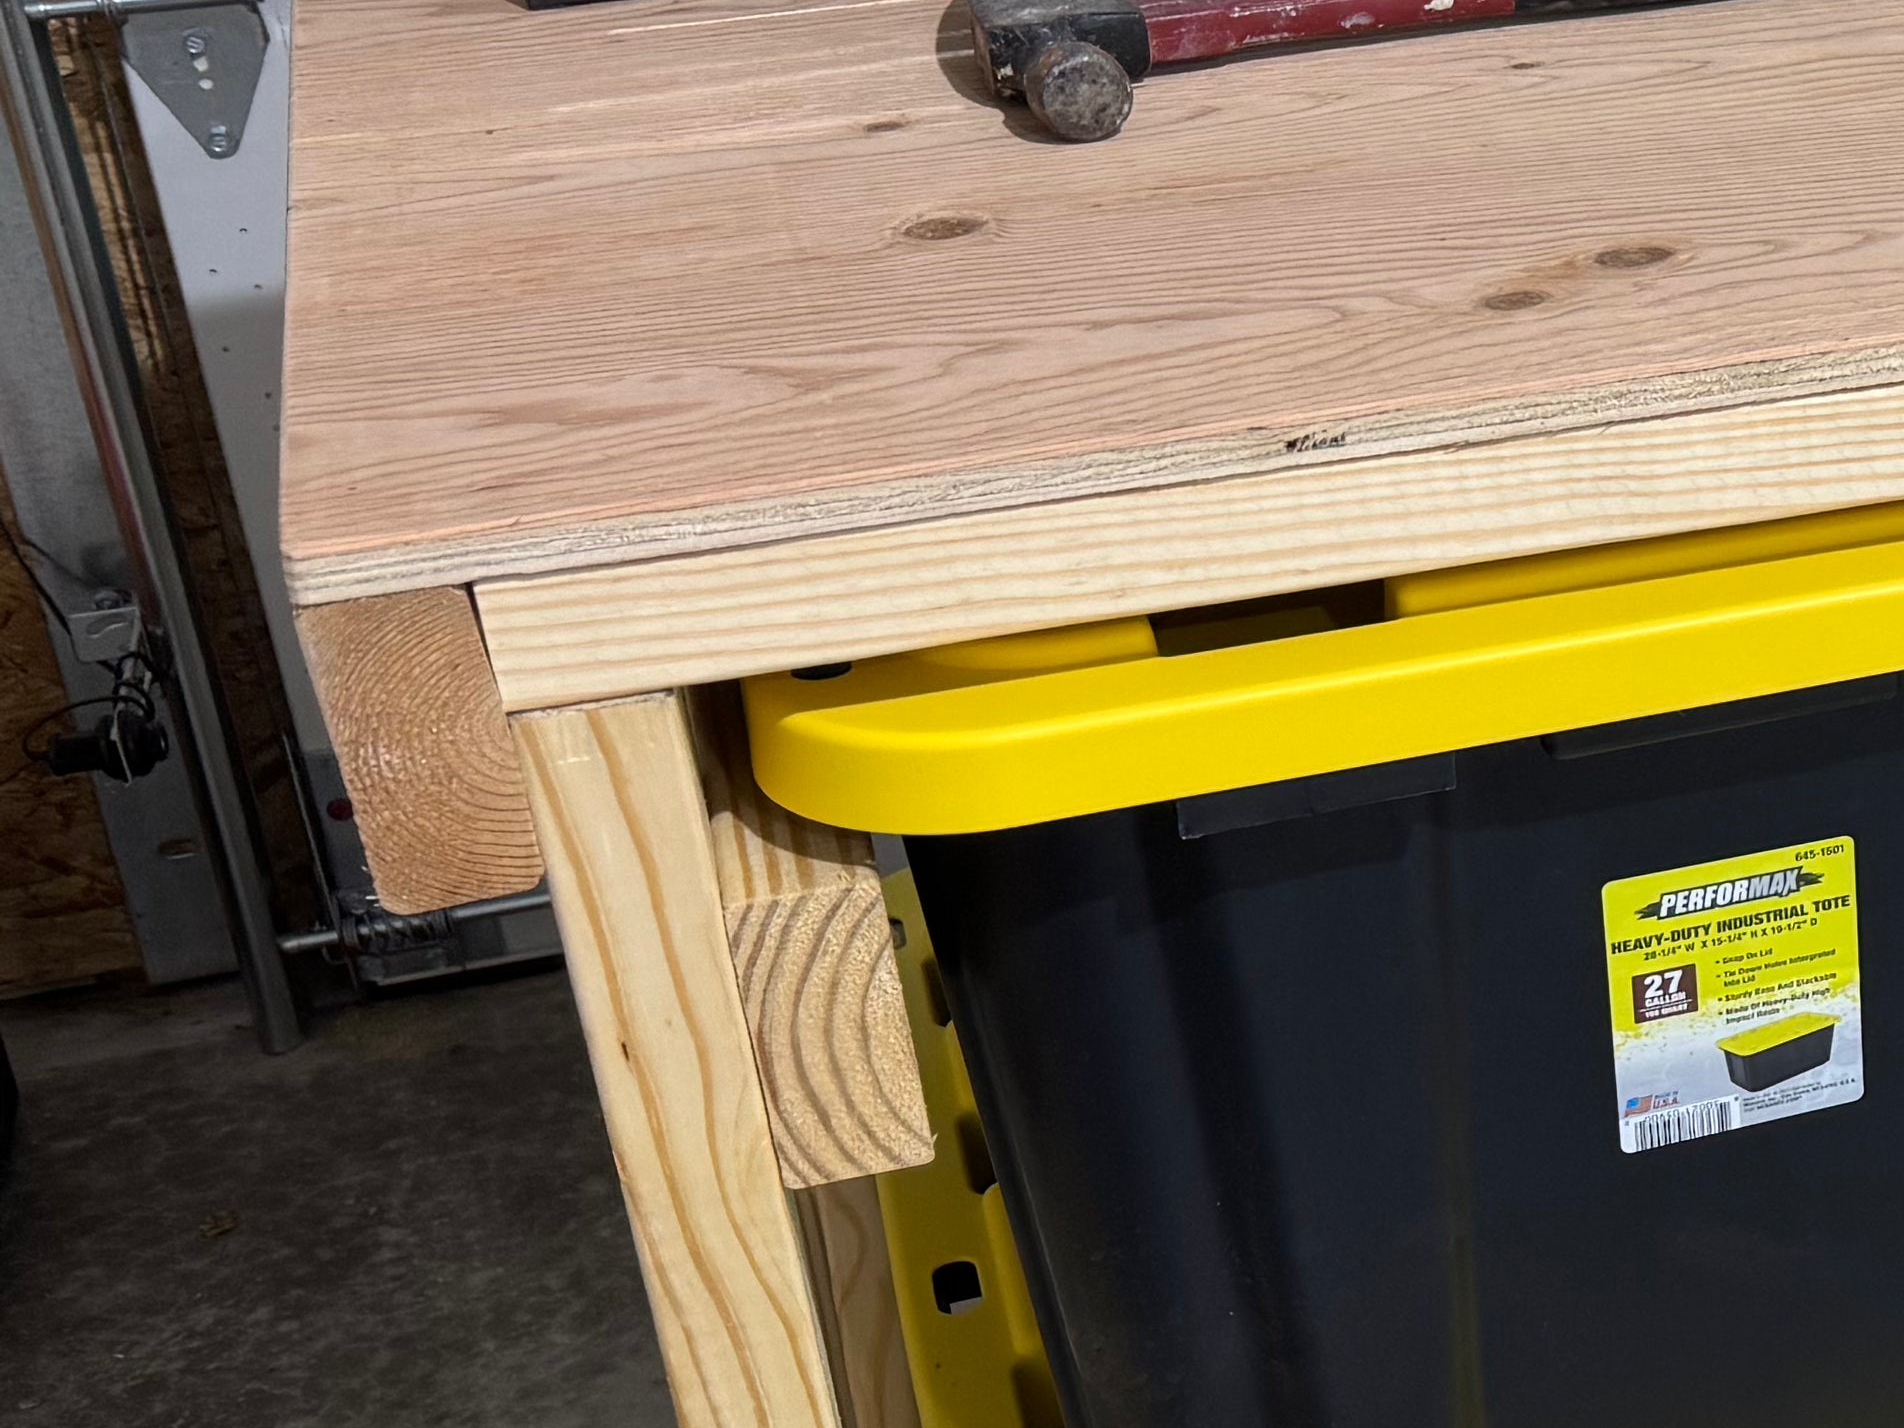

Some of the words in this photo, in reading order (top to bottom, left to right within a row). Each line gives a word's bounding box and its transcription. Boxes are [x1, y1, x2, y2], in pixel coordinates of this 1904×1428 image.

[1659, 868, 1798, 917] PERFORMAX
[1610, 922, 1711, 954] HEAVY-DUTY
[1716, 904, 1808, 933] INDUSTRIAL
[1812, 894, 1850, 912] TOTE
[1685, 943, 1694, 952] W
[1700, 940, 1707, 948] X
[1760, 928, 1768, 936] X
[1643, 969, 1682, 998] 27
[1644, 991, 1685, 1007] GALLON
